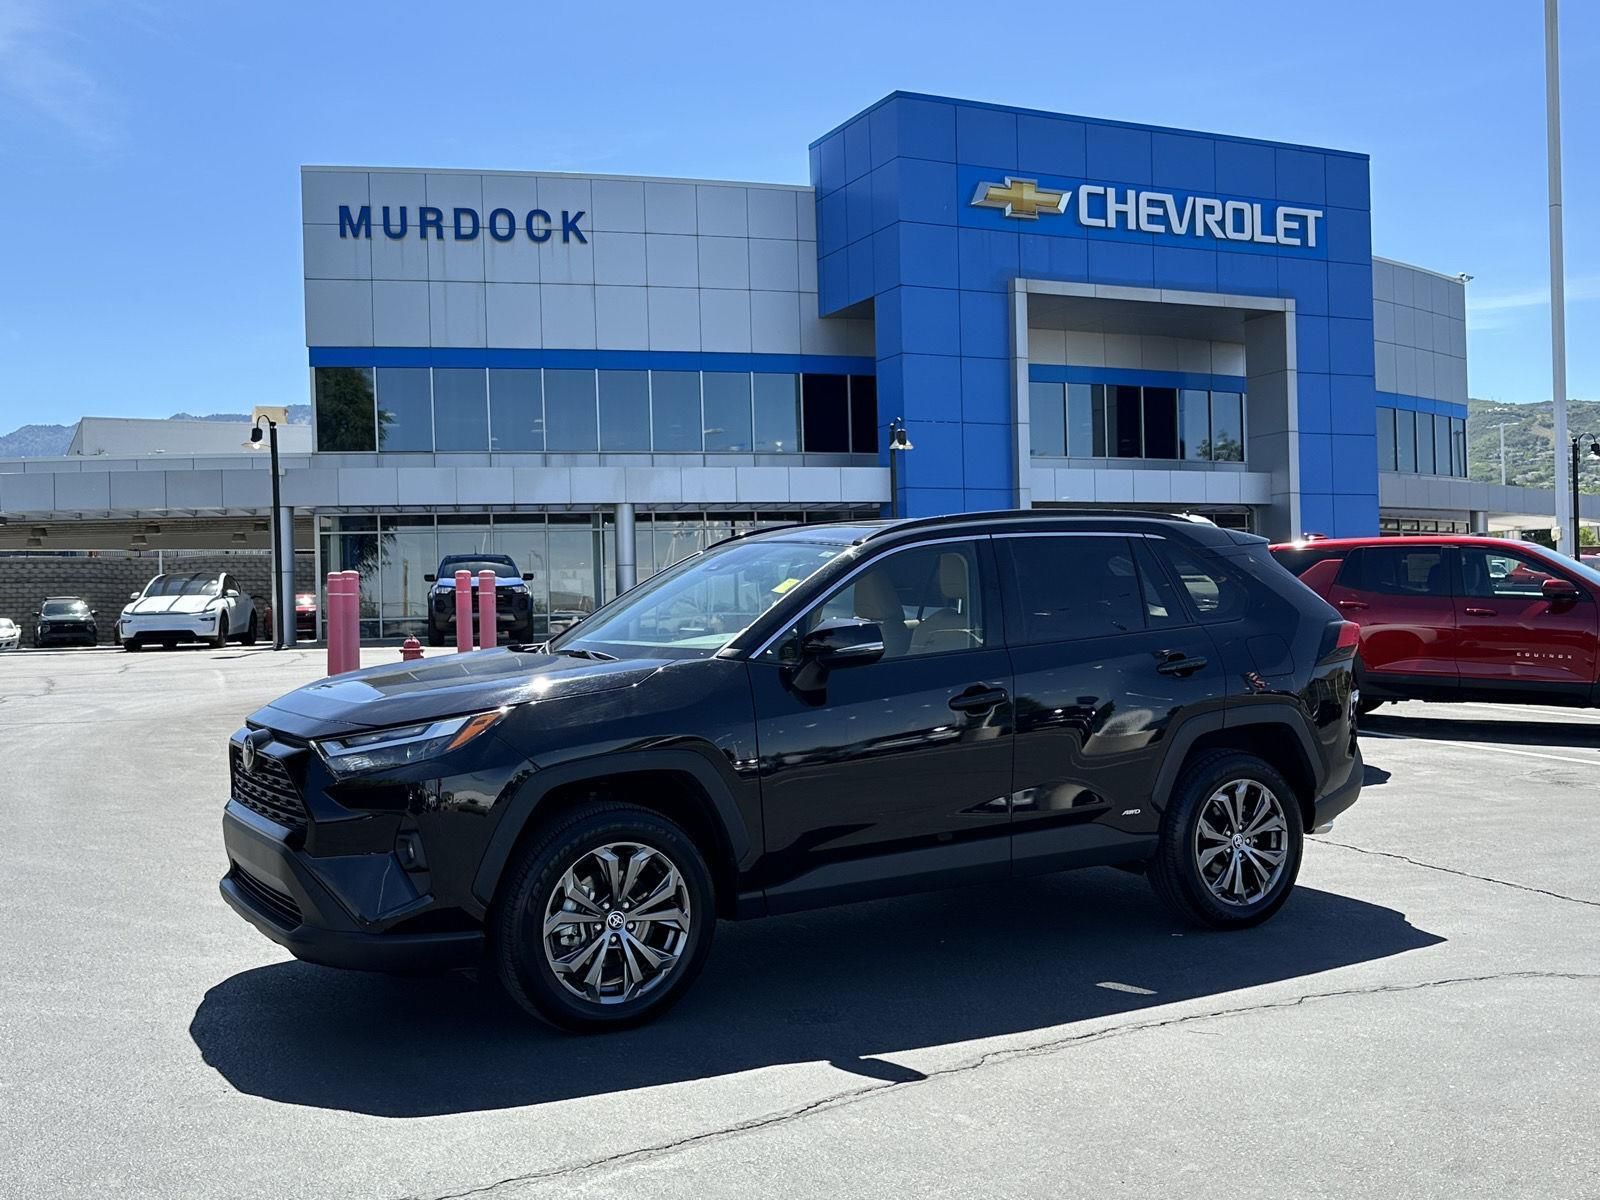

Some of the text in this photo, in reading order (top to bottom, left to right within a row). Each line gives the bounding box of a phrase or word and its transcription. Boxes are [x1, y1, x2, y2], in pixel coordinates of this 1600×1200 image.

[338, 205, 588, 245] MURDOCK
[1078, 184, 1323, 248] CHEVROLET
[1516, 651, 1573, 660] EQUINOX
[1121, 808, 1141, 816] AWD
